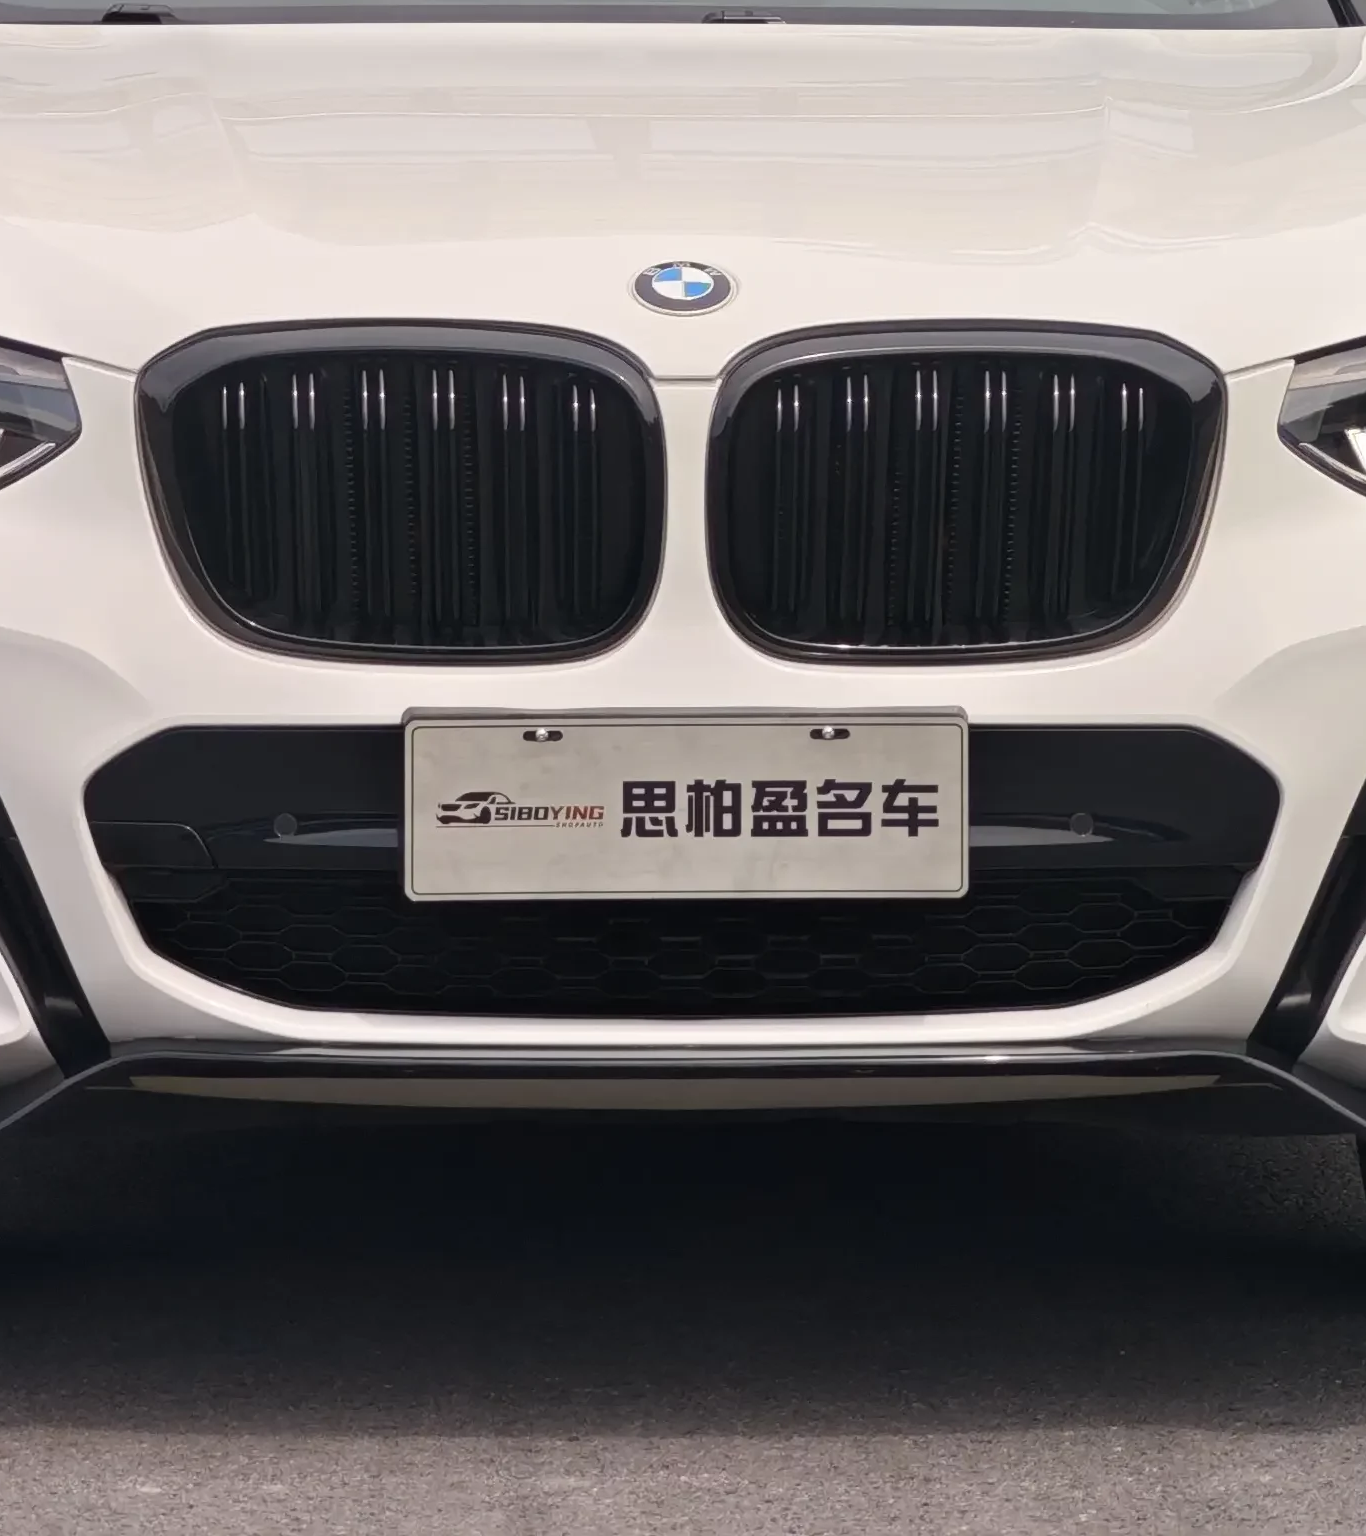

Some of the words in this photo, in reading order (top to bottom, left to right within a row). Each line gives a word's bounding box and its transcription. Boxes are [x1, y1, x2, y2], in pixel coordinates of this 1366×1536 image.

[494, 805, 605, 821] SIBOYING
[620, 778, 940, 839] 思柏盈名车
